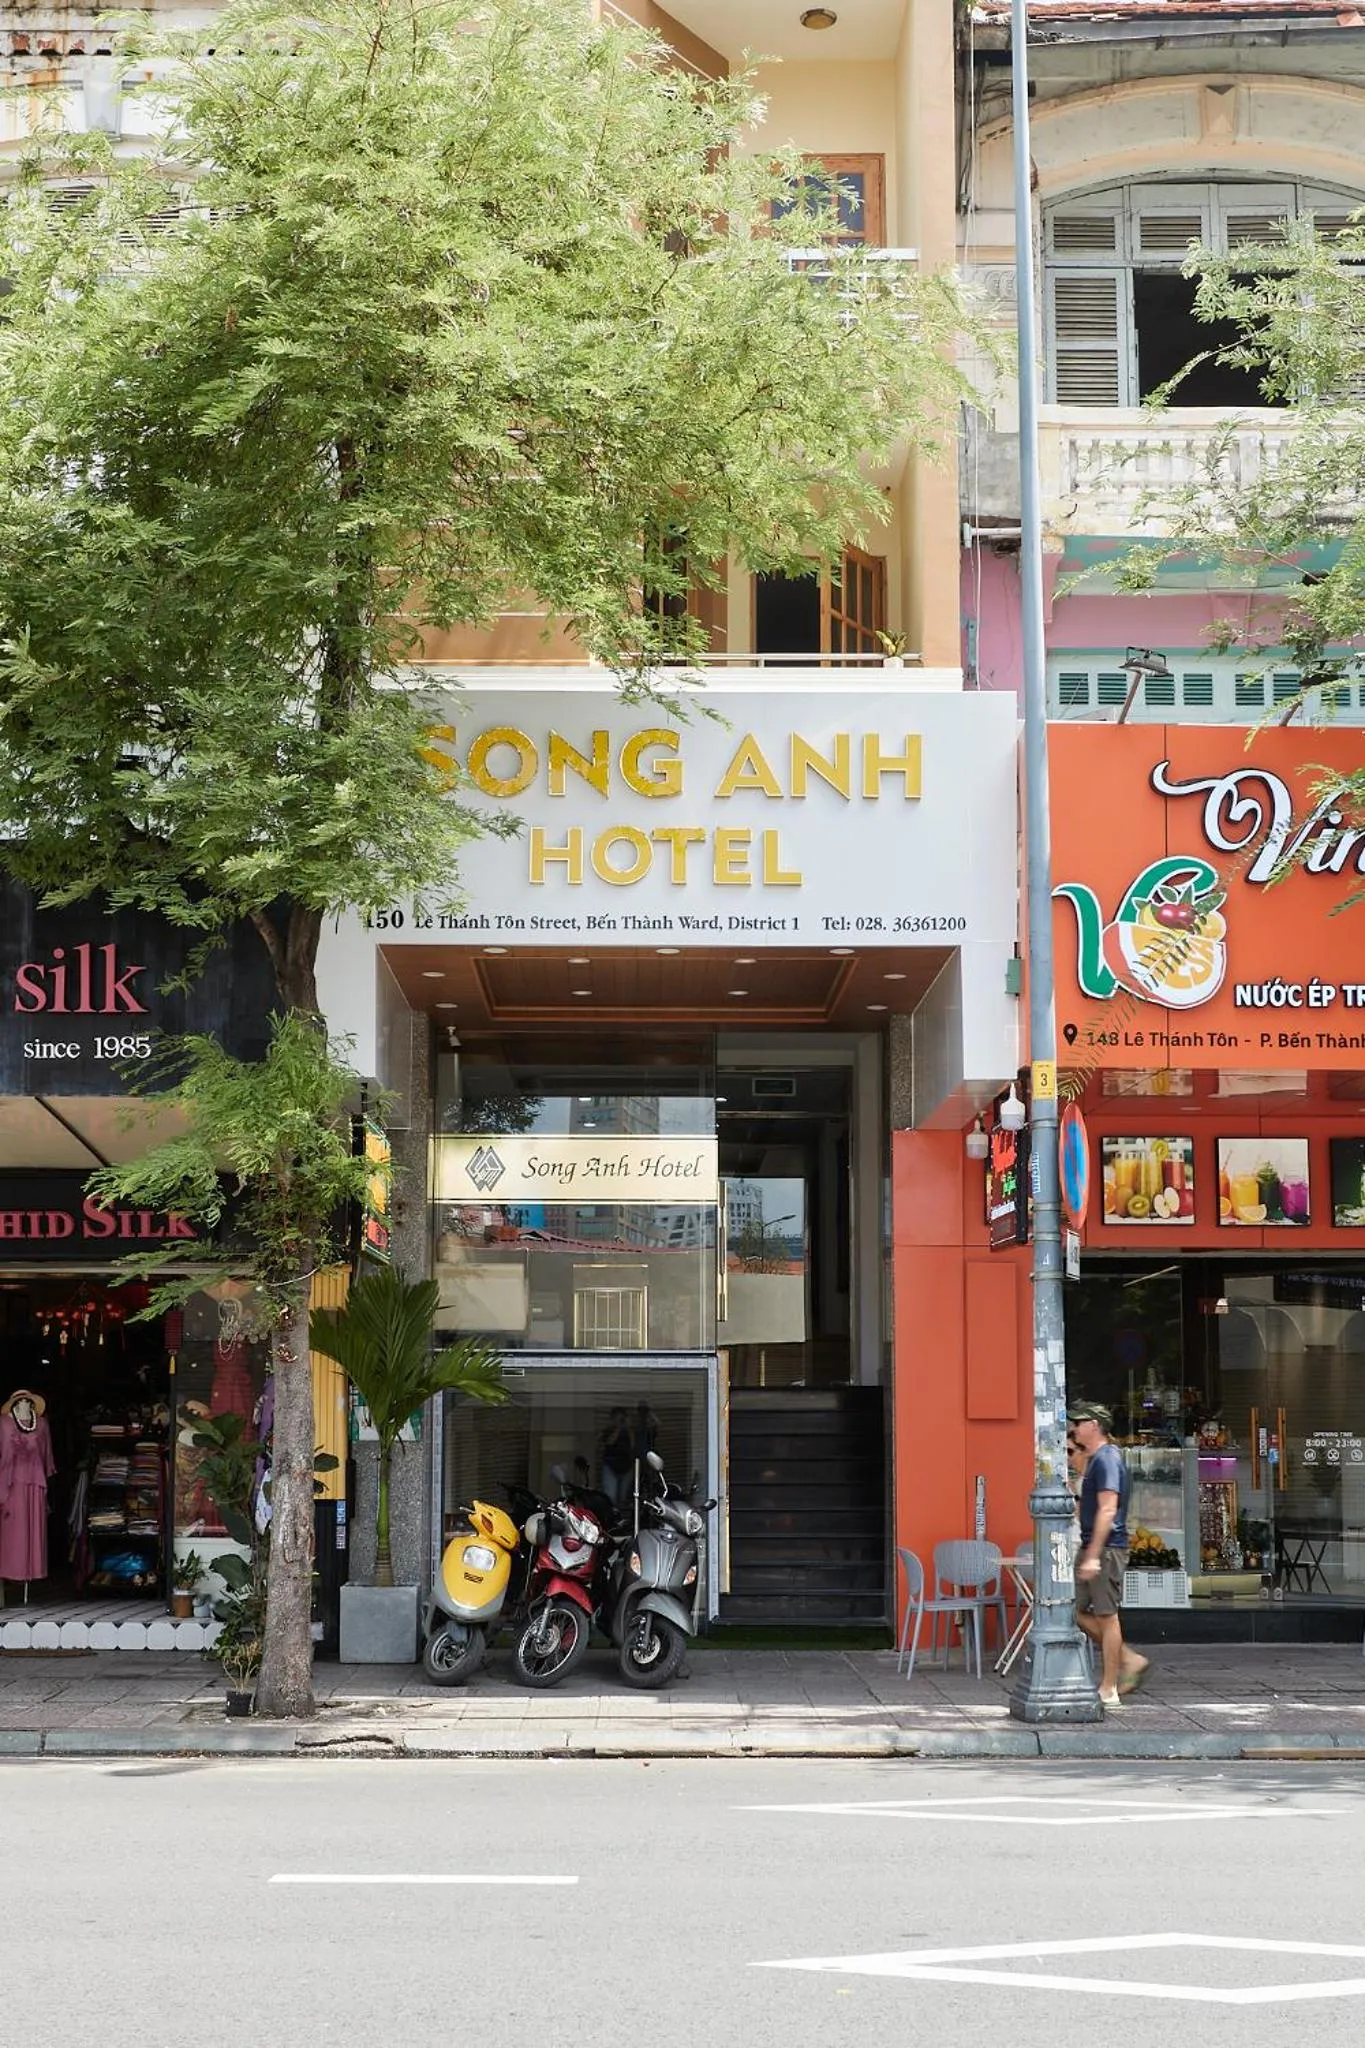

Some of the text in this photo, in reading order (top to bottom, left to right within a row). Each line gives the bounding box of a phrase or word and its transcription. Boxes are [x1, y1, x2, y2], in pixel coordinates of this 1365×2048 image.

[412, 724, 923, 800] SONG ANH
[529, 825, 801, 886] HOTEL
[363, 909, 404, 929] 150
[437, 913, 490, 930] Thánh
[495, 914, 525, 930] Tôn
[530, 915, 581, 932] Street,
[586, 912, 617, 930] Bến
[621, 913, 673, 931] Thành
[678, 916, 722, 931] Ward,
[728, 916, 786, 931] District
[792, 917, 799, 930] 1
[822, 917, 851, 931] Tel:
[855, 917, 887, 931] 028.
[893, 917, 966, 933] 36361200
[14, 942, 149, 1013] silk
[1235, 977, 1303, 1007] NƯỚC
[1308, 978, 1336, 1007] ÉP
[24, 1036, 151, 1059] since 1985
[1124, 1032, 1144, 1047] Lê
[1149, 1031, 1203, 1047] Thánh
[1207, 1032, 1239, 1047] Tôn
[1261, 1034, 1273, 1048] P.
[1278, 1031, 1311, 1048] Bến
[1041, 1072, 1048, 1087] 3
[521, 1154, 704, 1184] Song Anh Hotel
[0, 1210, 75, 1238] HID
